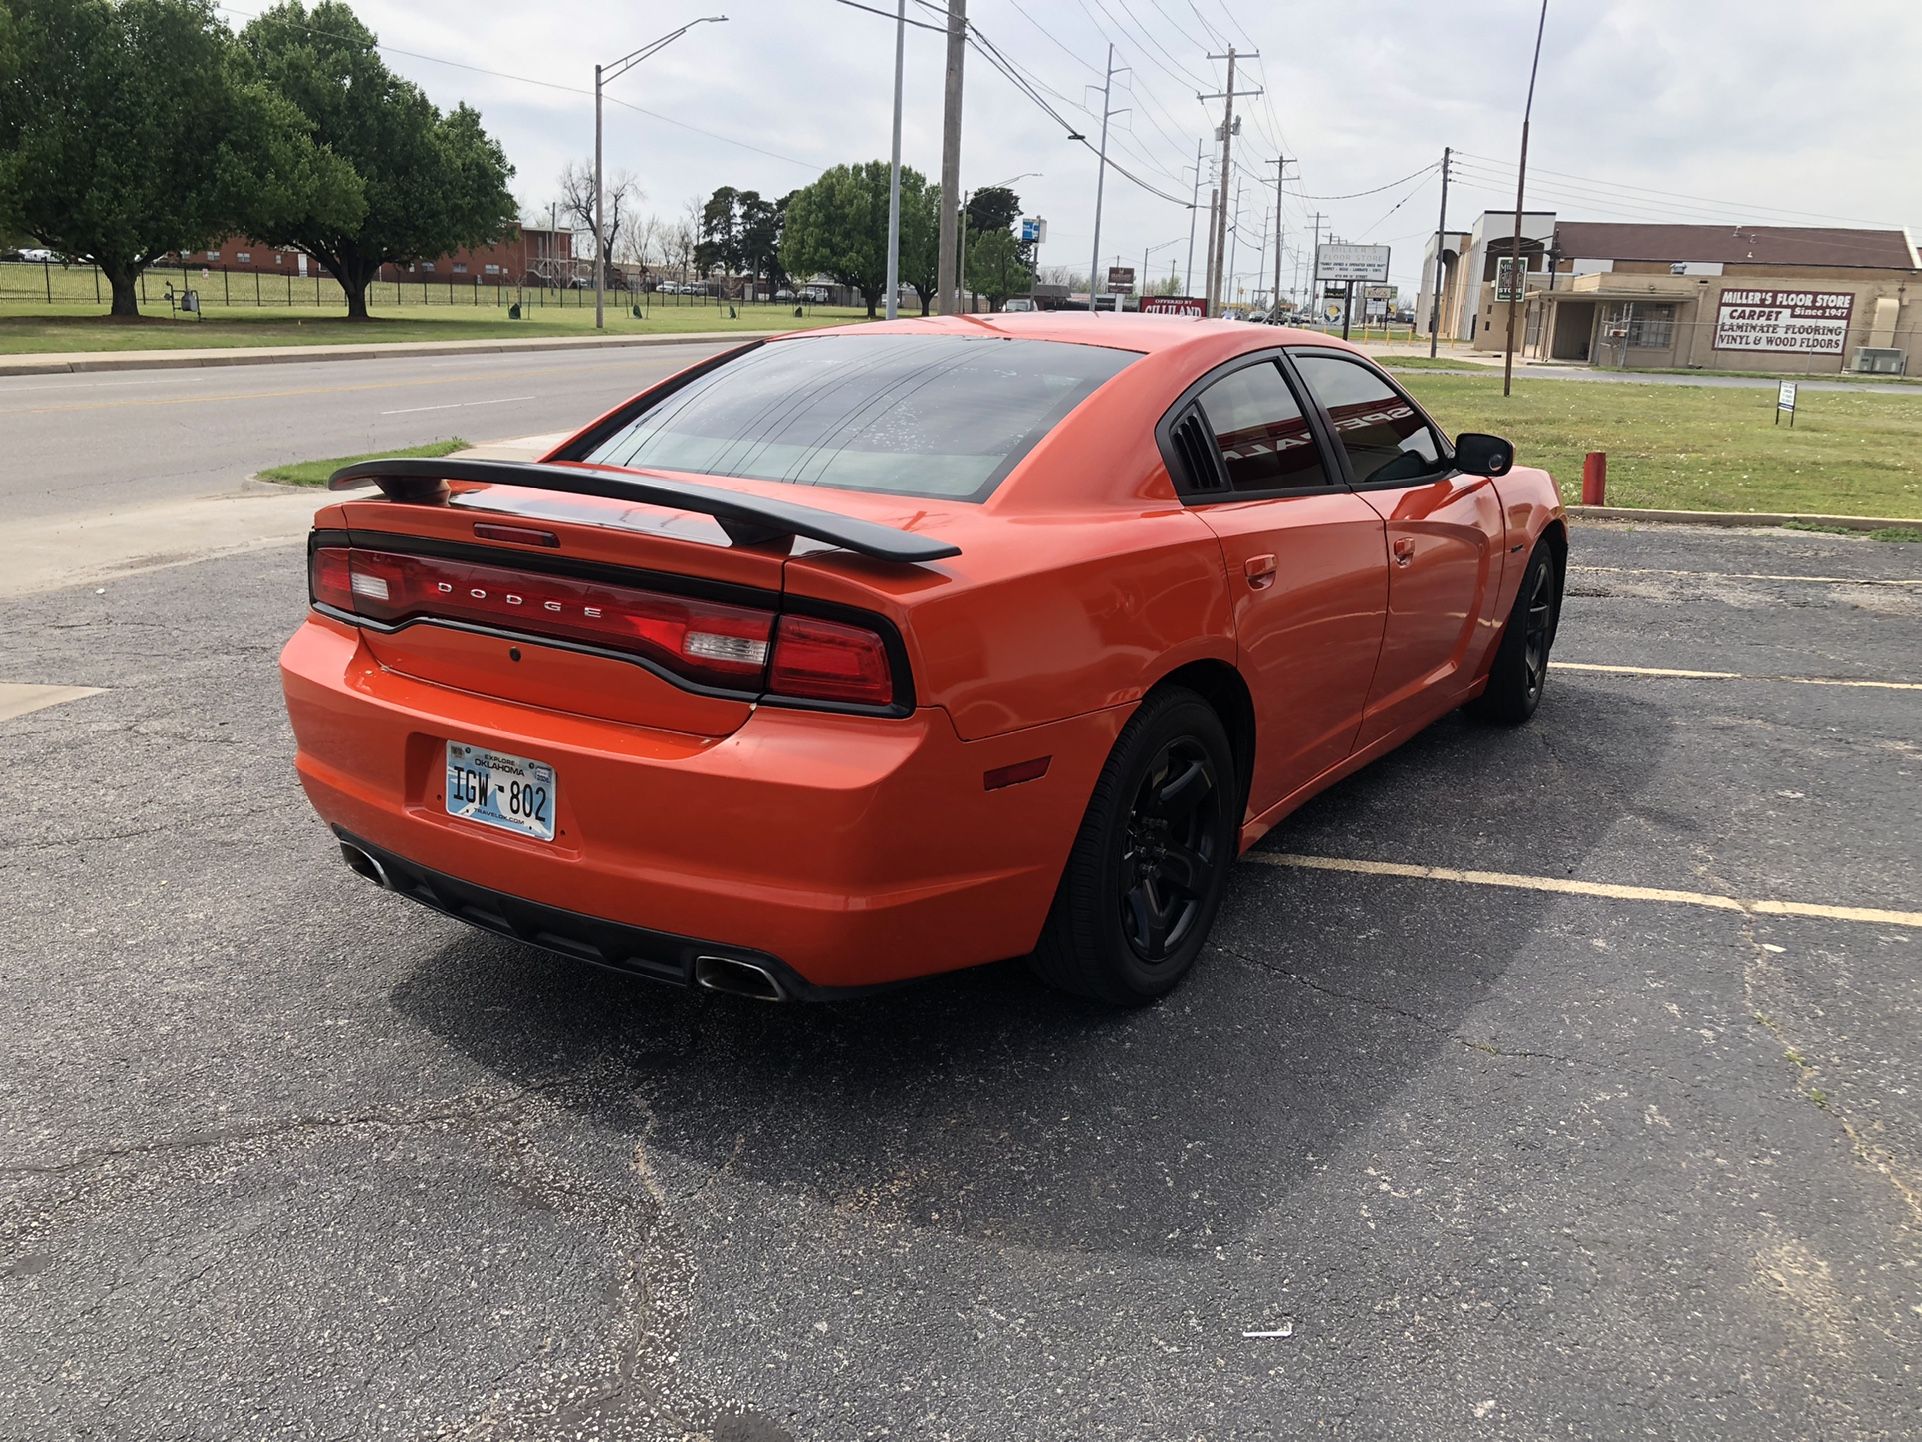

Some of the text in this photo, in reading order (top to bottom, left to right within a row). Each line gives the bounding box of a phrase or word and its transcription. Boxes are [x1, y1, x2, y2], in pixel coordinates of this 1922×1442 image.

[1721, 291, 1852, 308] MILLER'S FLOOR STORE
[1728, 309, 1782, 321] CARPET
[1793, 307, 1848, 317] Since 1947
[1720, 322, 1842, 336] LAMINATE FLOORING
[1719, 334, 1840, 349] VINYL & WOOD FLOORS
[438, 582, 602, 618] DODGE
[475, 758, 525, 777] OKLAHOMA
[484, 754, 515, 767] EXPLORE
